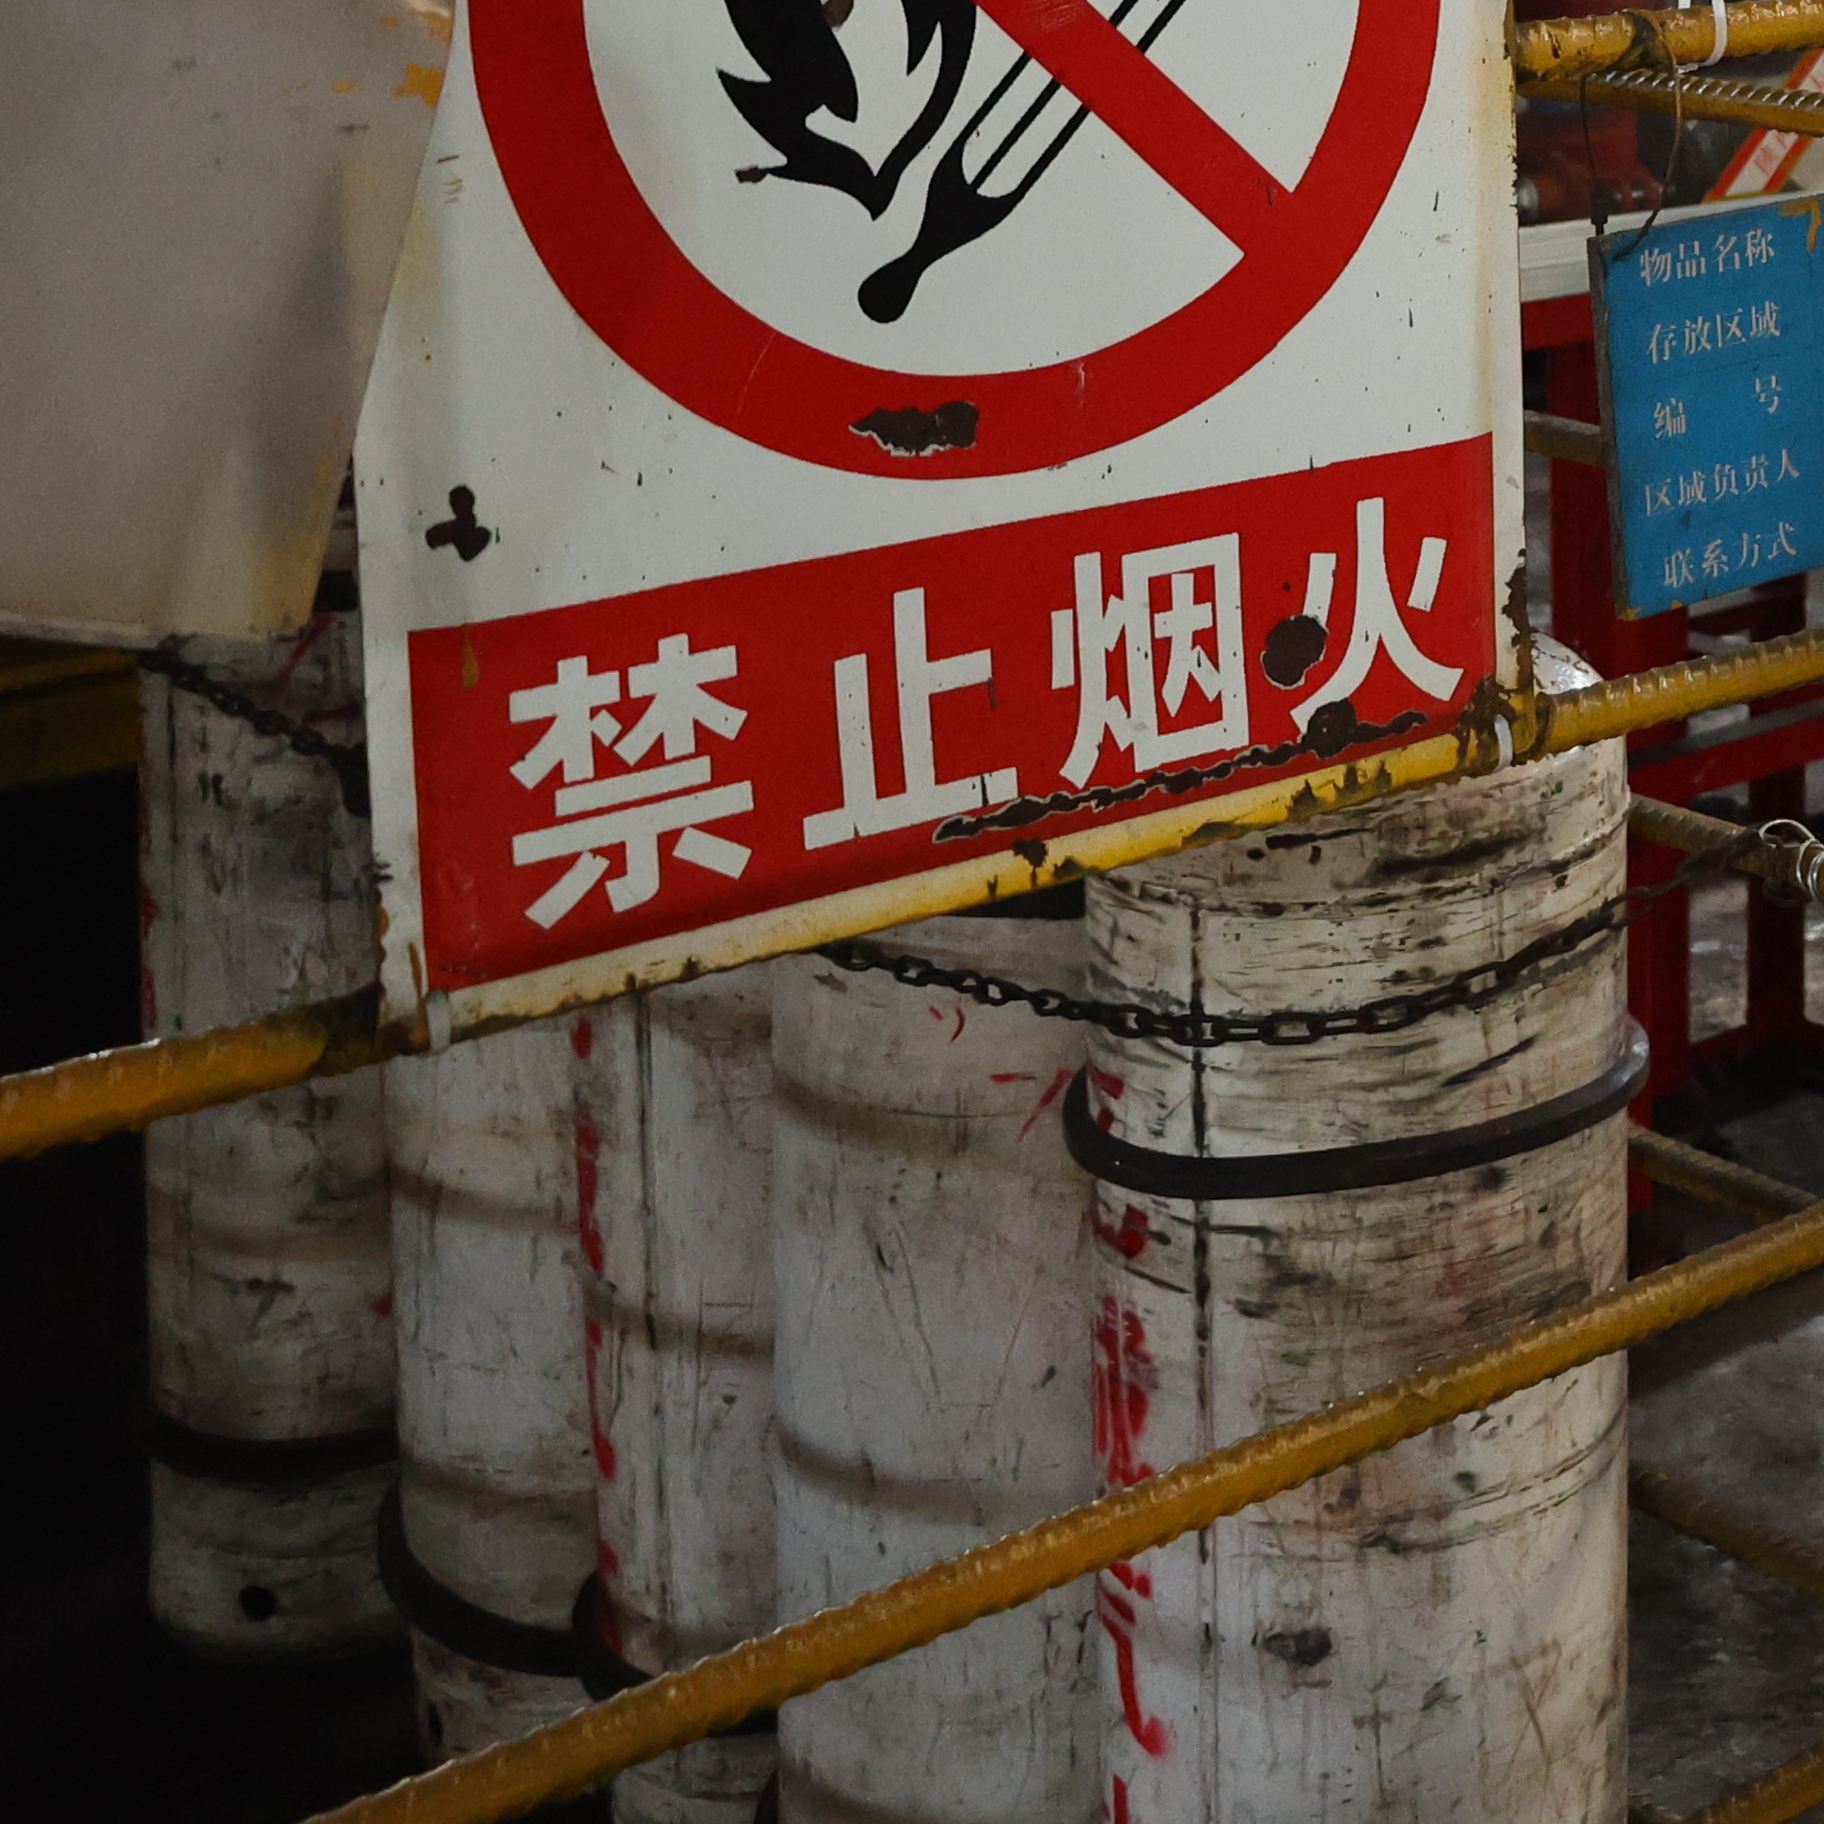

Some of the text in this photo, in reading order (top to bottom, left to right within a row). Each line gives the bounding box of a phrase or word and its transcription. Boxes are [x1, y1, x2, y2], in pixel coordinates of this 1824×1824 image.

[1640, 228, 1775, 287] 物品名称
[1648, 301, 1781, 364] 存放区域
[1653, 375, 1782, 438] 编号
[1645, 448, 1800, 517] 区域负责人
[1663, 522, 1797, 588] 联系方式
[509, 497, 1463, 931] 禁止烟火
